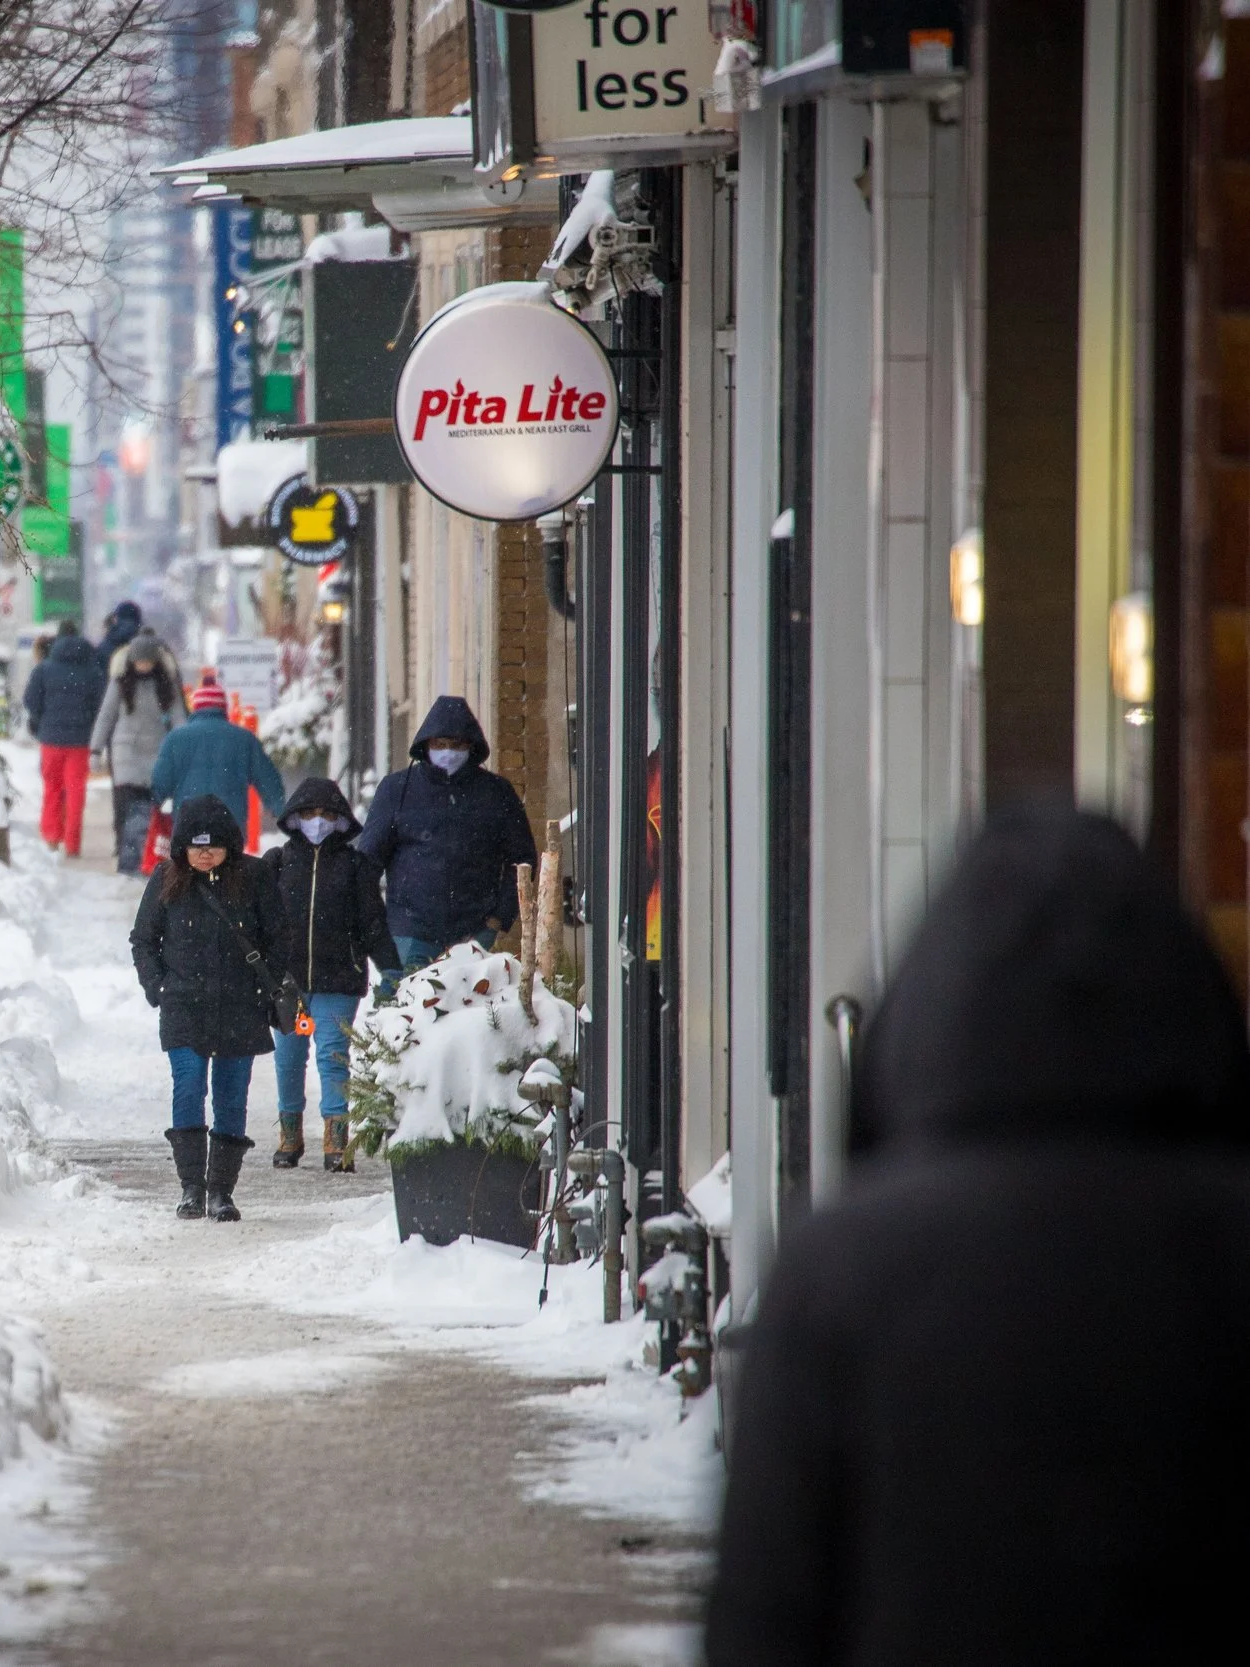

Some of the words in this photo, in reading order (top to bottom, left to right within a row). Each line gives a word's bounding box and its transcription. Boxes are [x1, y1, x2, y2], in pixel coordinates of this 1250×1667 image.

[584, 0, 677, 48] for
[577, 59, 688, 112] less
[516, 374, 607, 422] Lite
[447, 427, 516, 438] MEDITERRANEAN
[524, 425, 546, 435] NEAR
[547, 424, 568, 434] EAST
[568, 423, 592, 433] GRILL
